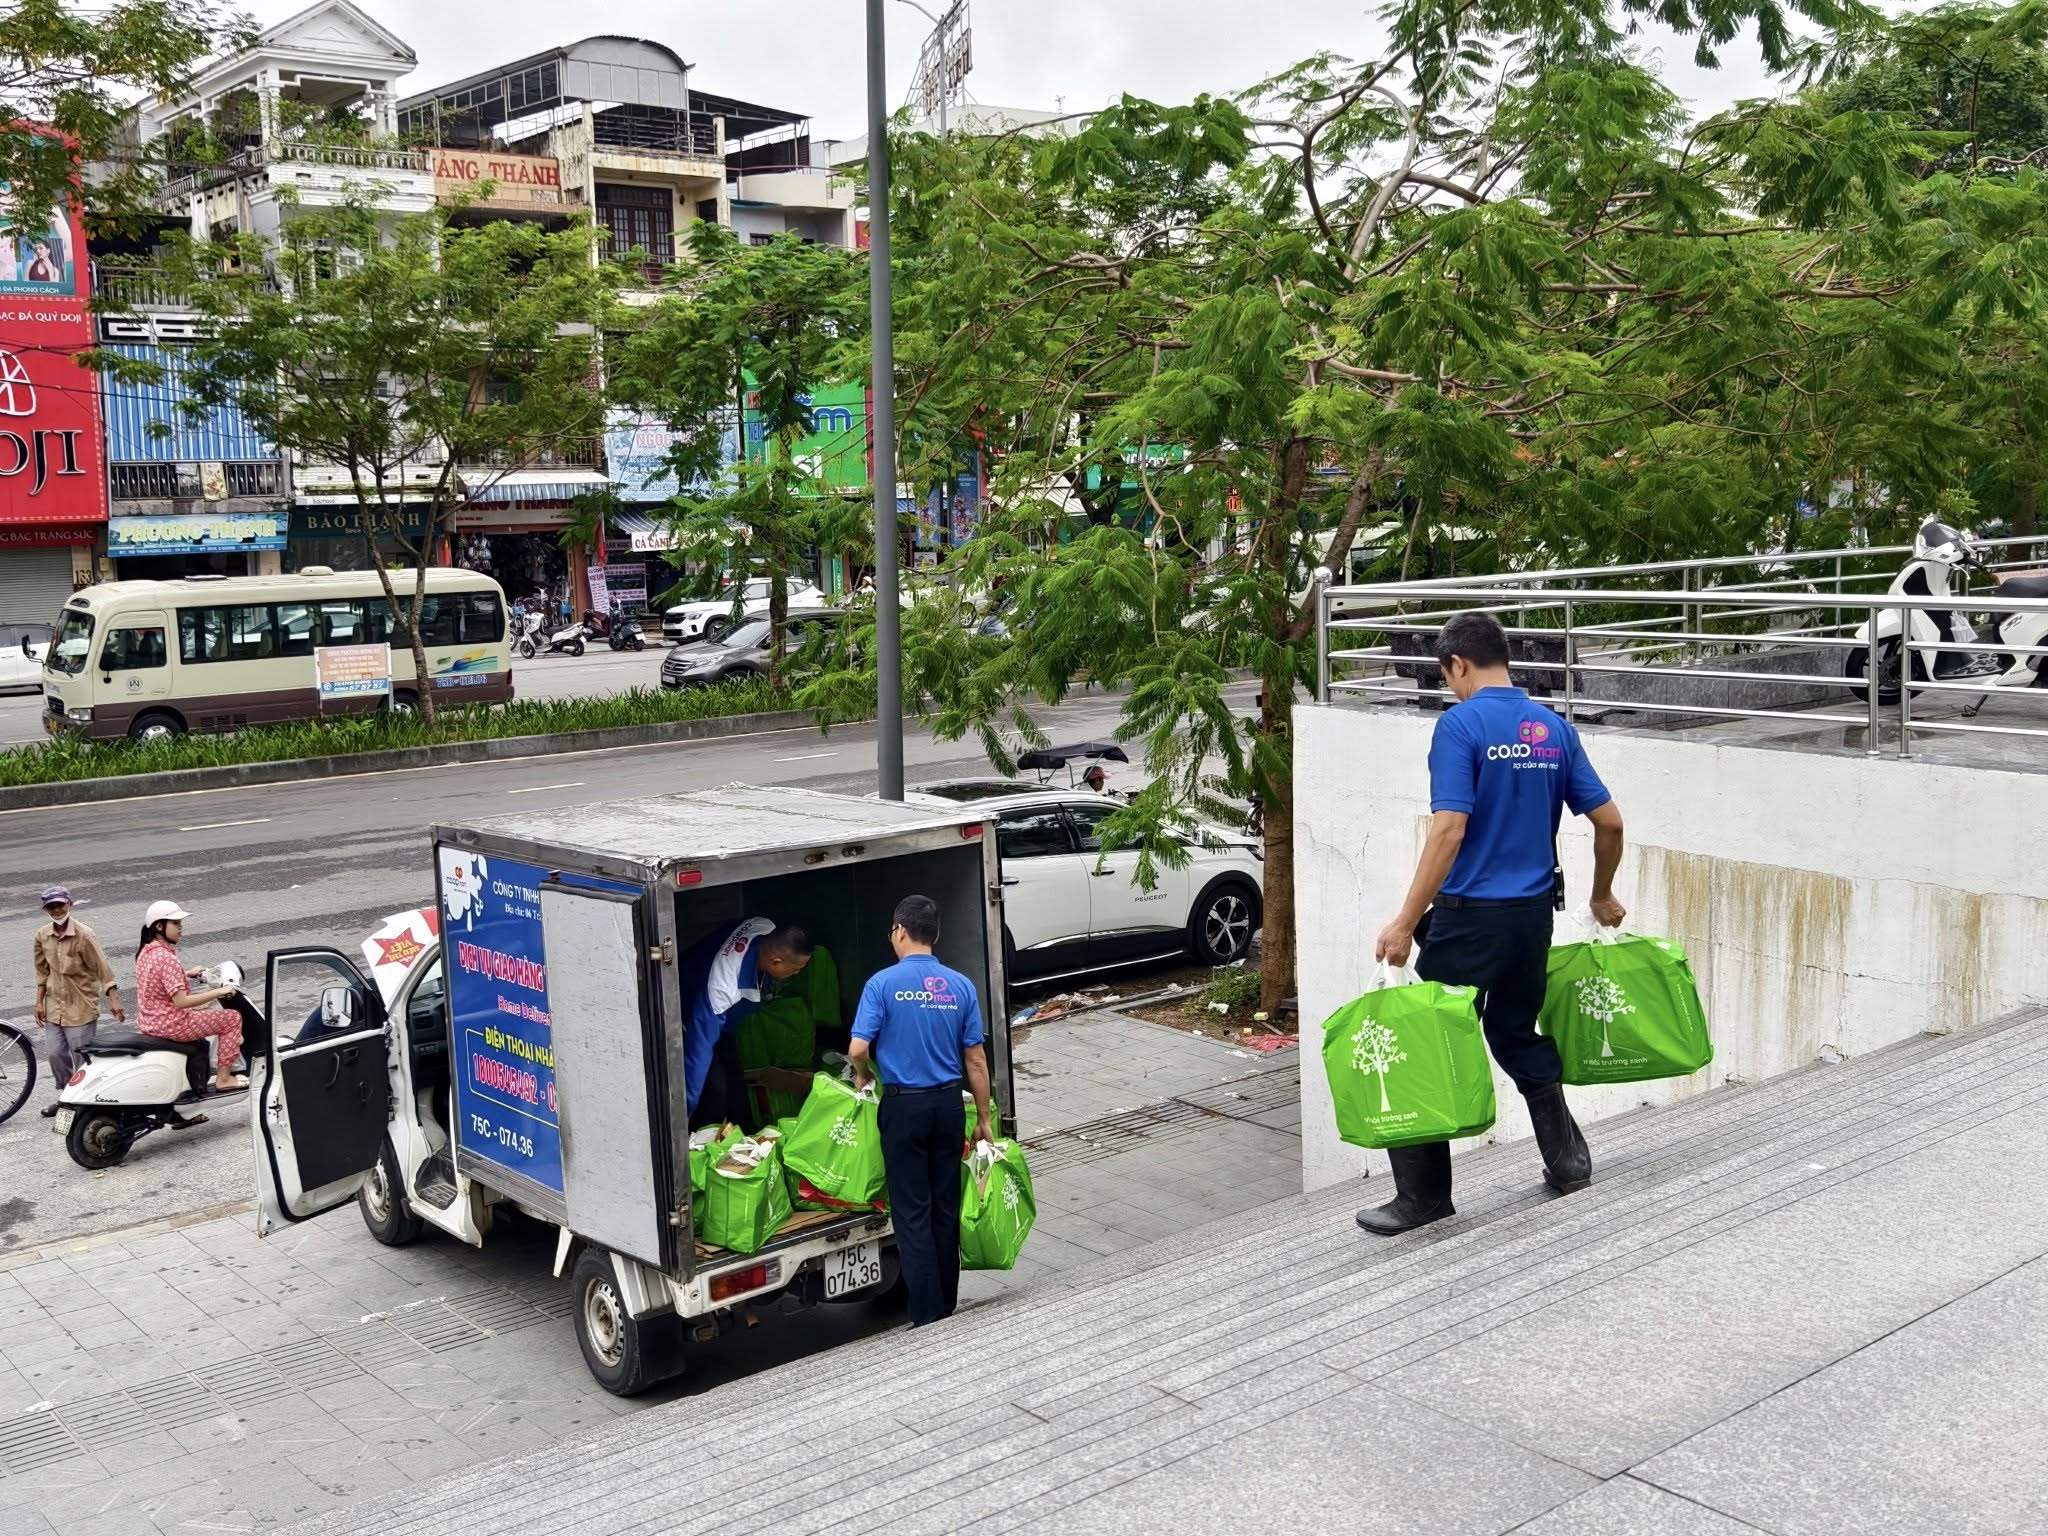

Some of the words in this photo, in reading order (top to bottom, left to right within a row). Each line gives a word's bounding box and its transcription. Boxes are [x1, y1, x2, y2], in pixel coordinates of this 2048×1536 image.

[489, 160, 560, 186] THÀNH
[0, 311, 15, 321] ẠC
[60, 313, 82, 323] DOJI
[34, 529, 72, 541] TRANG
[492, 878, 513, 898] CÔNG
[514, 886, 522, 900] TY
[522, 887, 540, 904] TNHH
[1135, 894, 1167, 902] PEUGEOT
[459, 941, 479, 974] DỊCH
[478, 946, 492, 981] VỤ
[493, 951, 516, 983] GIAO
[516, 955, 544, 992] HÀNG
[498, 994, 521, 1016] Home
[485, 1026, 506, 1052] ĐIỆN
[506, 1034, 534, 1064] THOẠI
[471, 1114, 491, 1138] 75C
[499, 1126, 534, 1158] 074.36
[837, 1243, 866, 1269] 75C
[826, 1261, 880, 1296] 074.36
